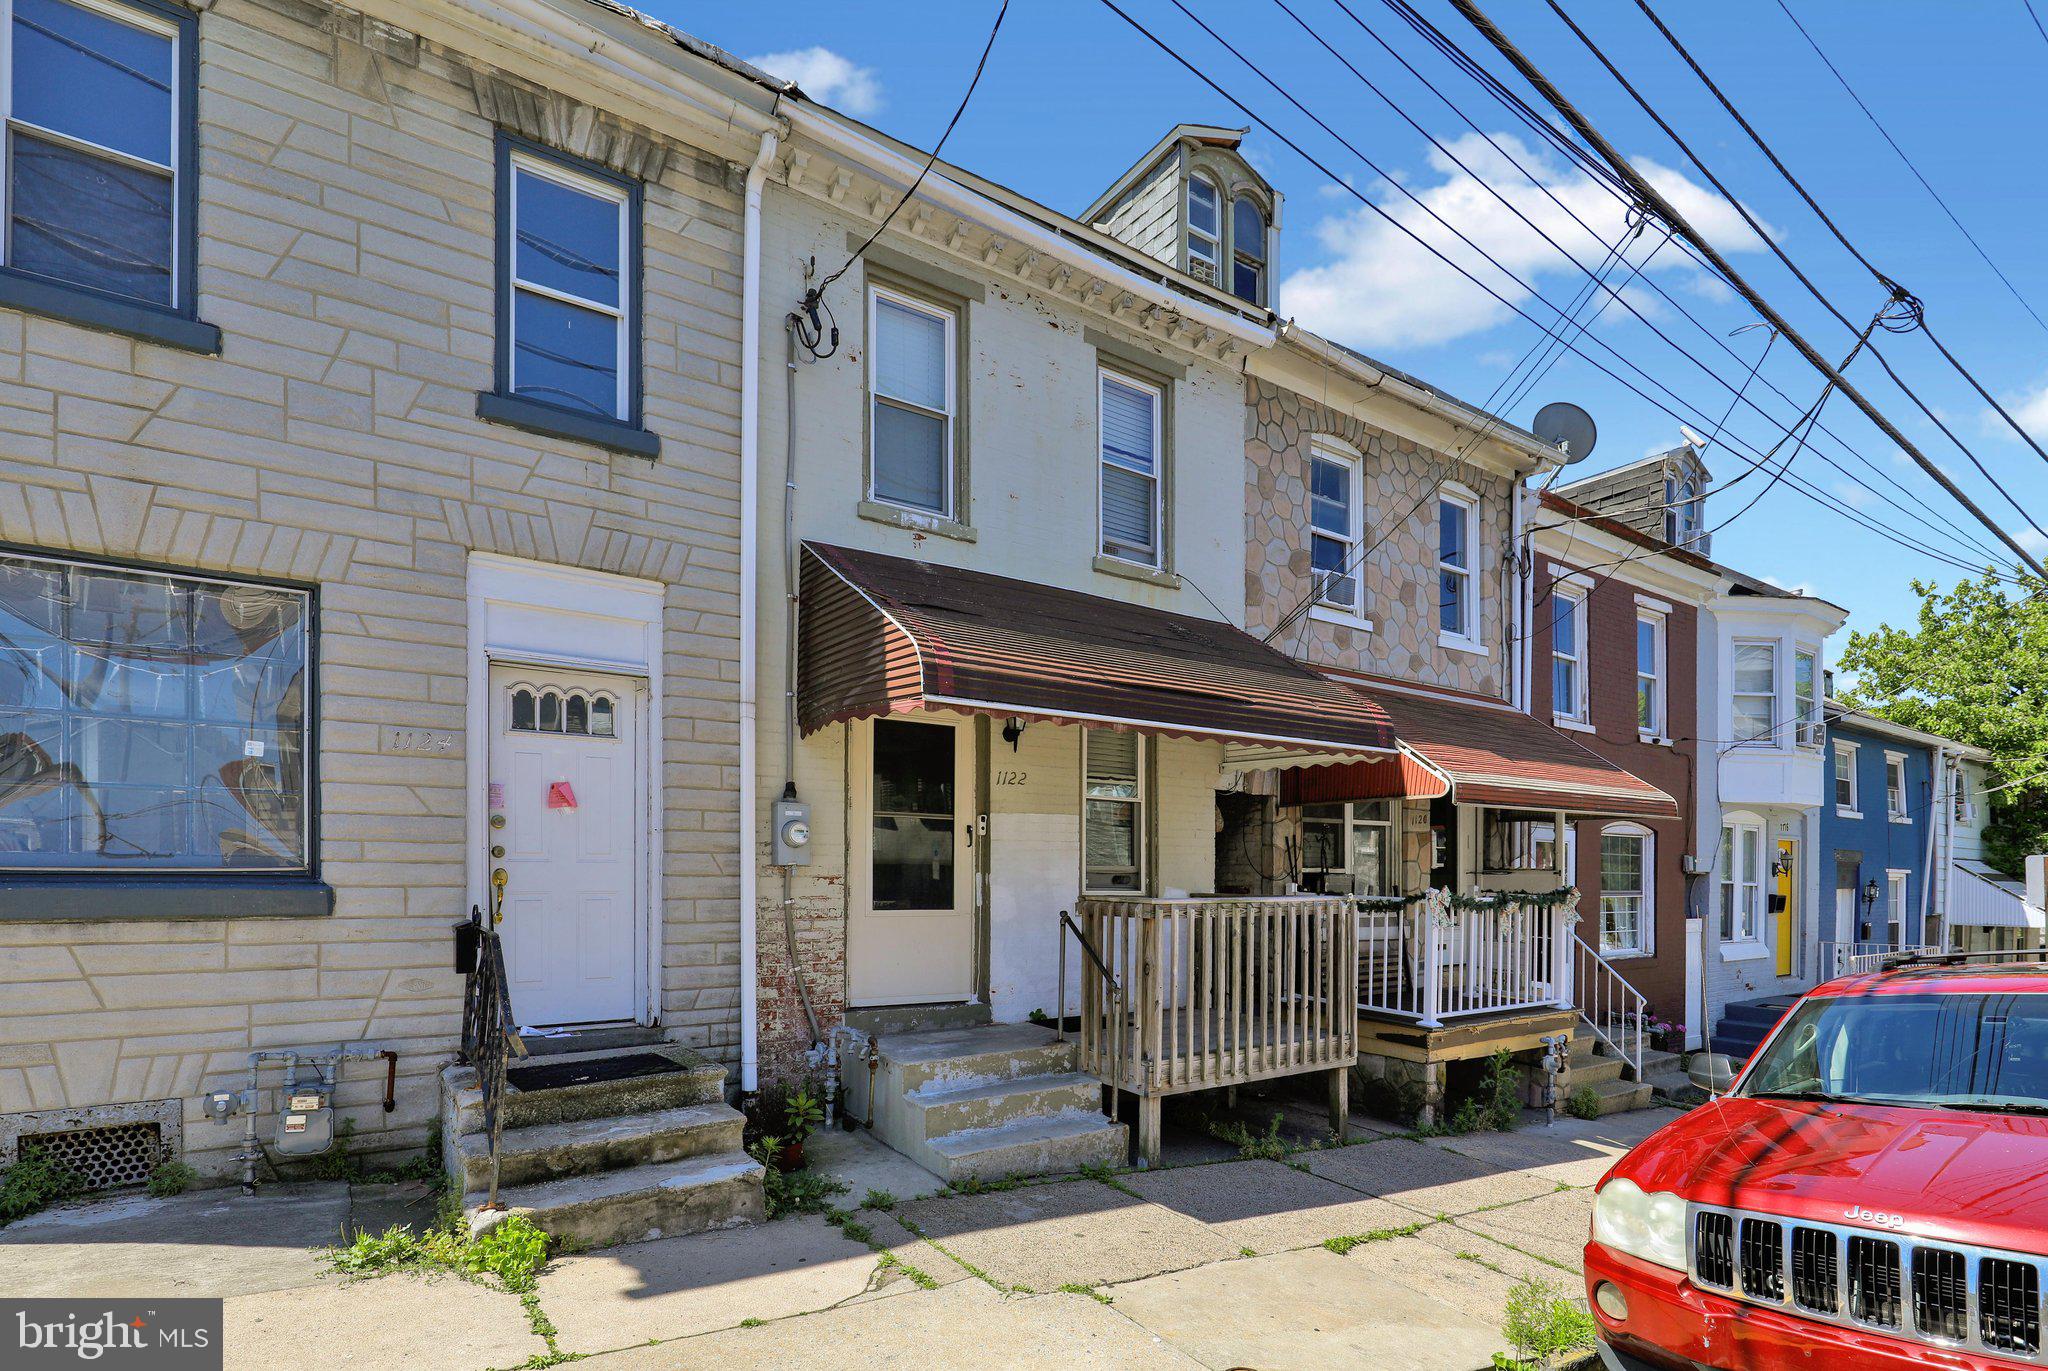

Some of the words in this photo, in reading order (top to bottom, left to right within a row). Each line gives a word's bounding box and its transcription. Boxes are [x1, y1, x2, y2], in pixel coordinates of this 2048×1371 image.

[392, 731, 454, 752] 1124
[995, 770, 1027, 786] 1122
[1843, 1205, 1904, 1229] Jeep
